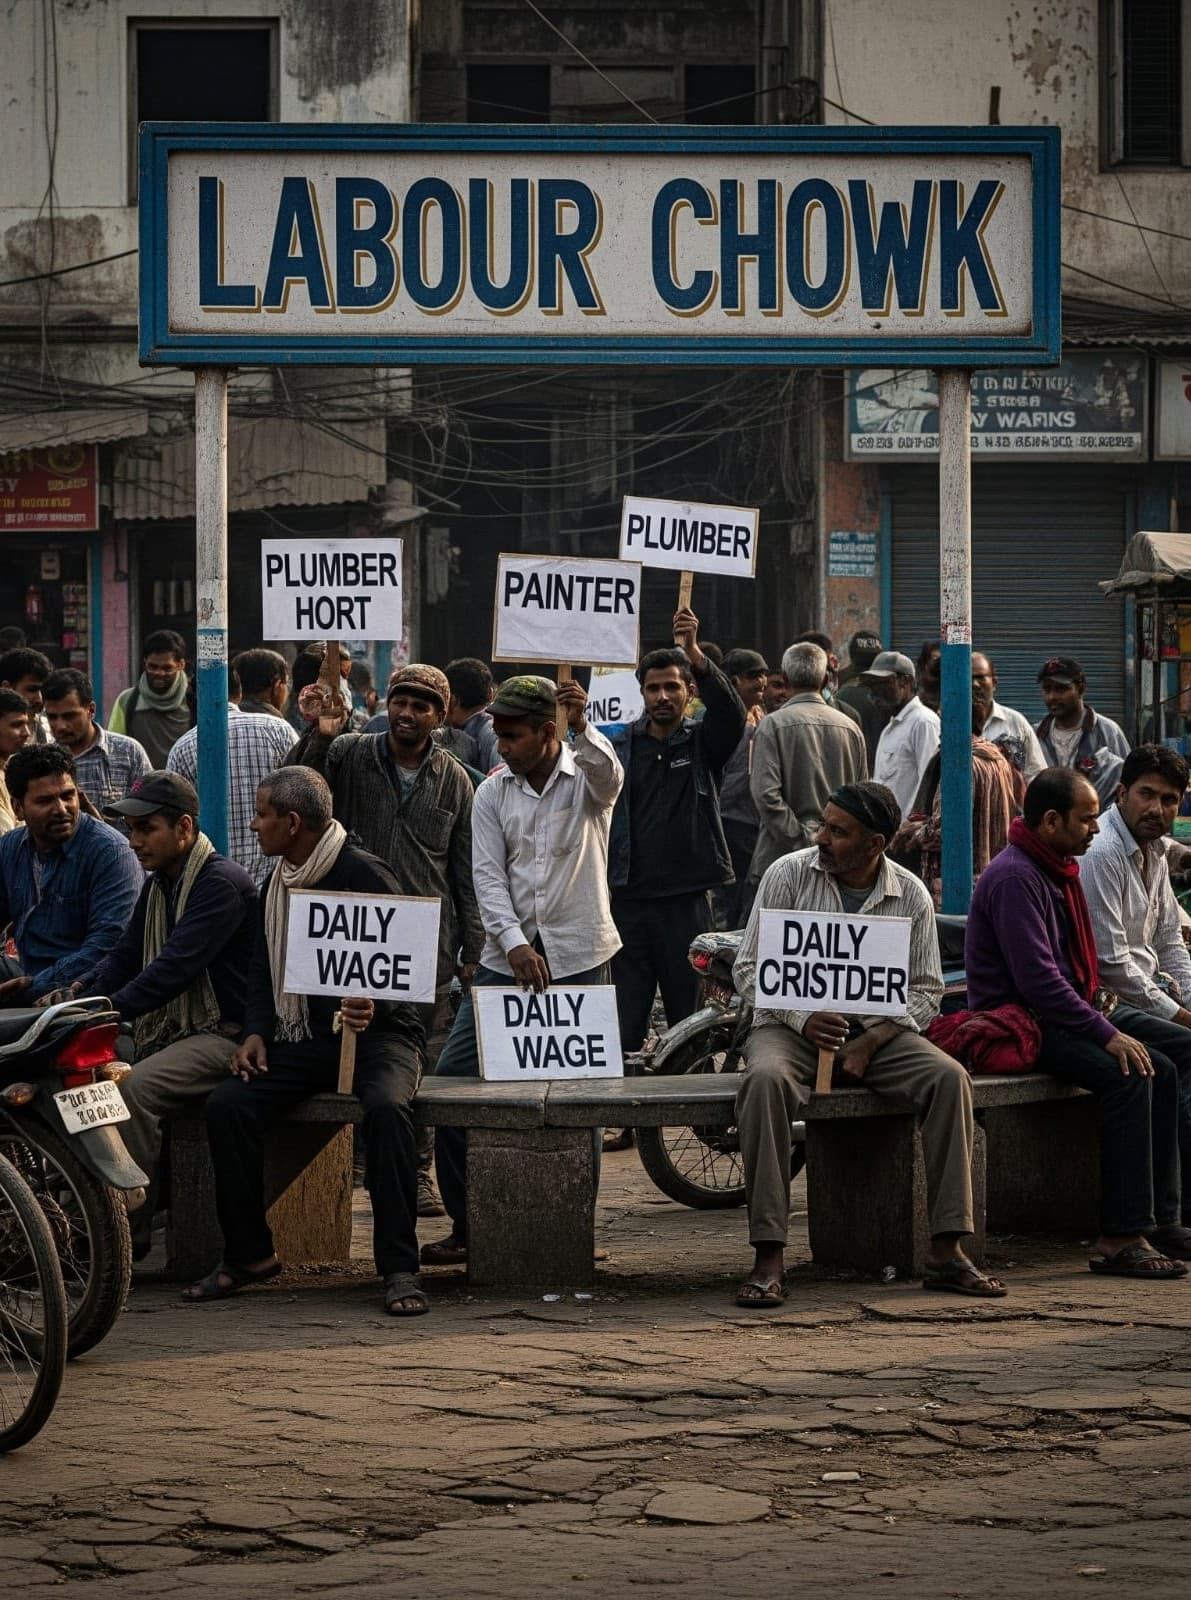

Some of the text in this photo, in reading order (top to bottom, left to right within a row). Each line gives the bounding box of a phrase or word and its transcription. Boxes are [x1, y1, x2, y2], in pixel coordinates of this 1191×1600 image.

[199, 176, 1008, 318] LABOUR CHOWK
[626, 513, 751, 559] PLUMBER
[265, 552, 398, 588] PLUMBER
[295, 595, 372, 630] HORT
[504, 570, 635, 615] PAINTER
[307, 902, 397, 944] DAILY
[782, 919, 869, 961] DAILY
[316, 948, 412, 991] WAGE
[758, 958, 907, 1005] CRISTDER
[502, 993, 585, 1028] DAILY
[512, 1034, 607, 1069] WAGE
